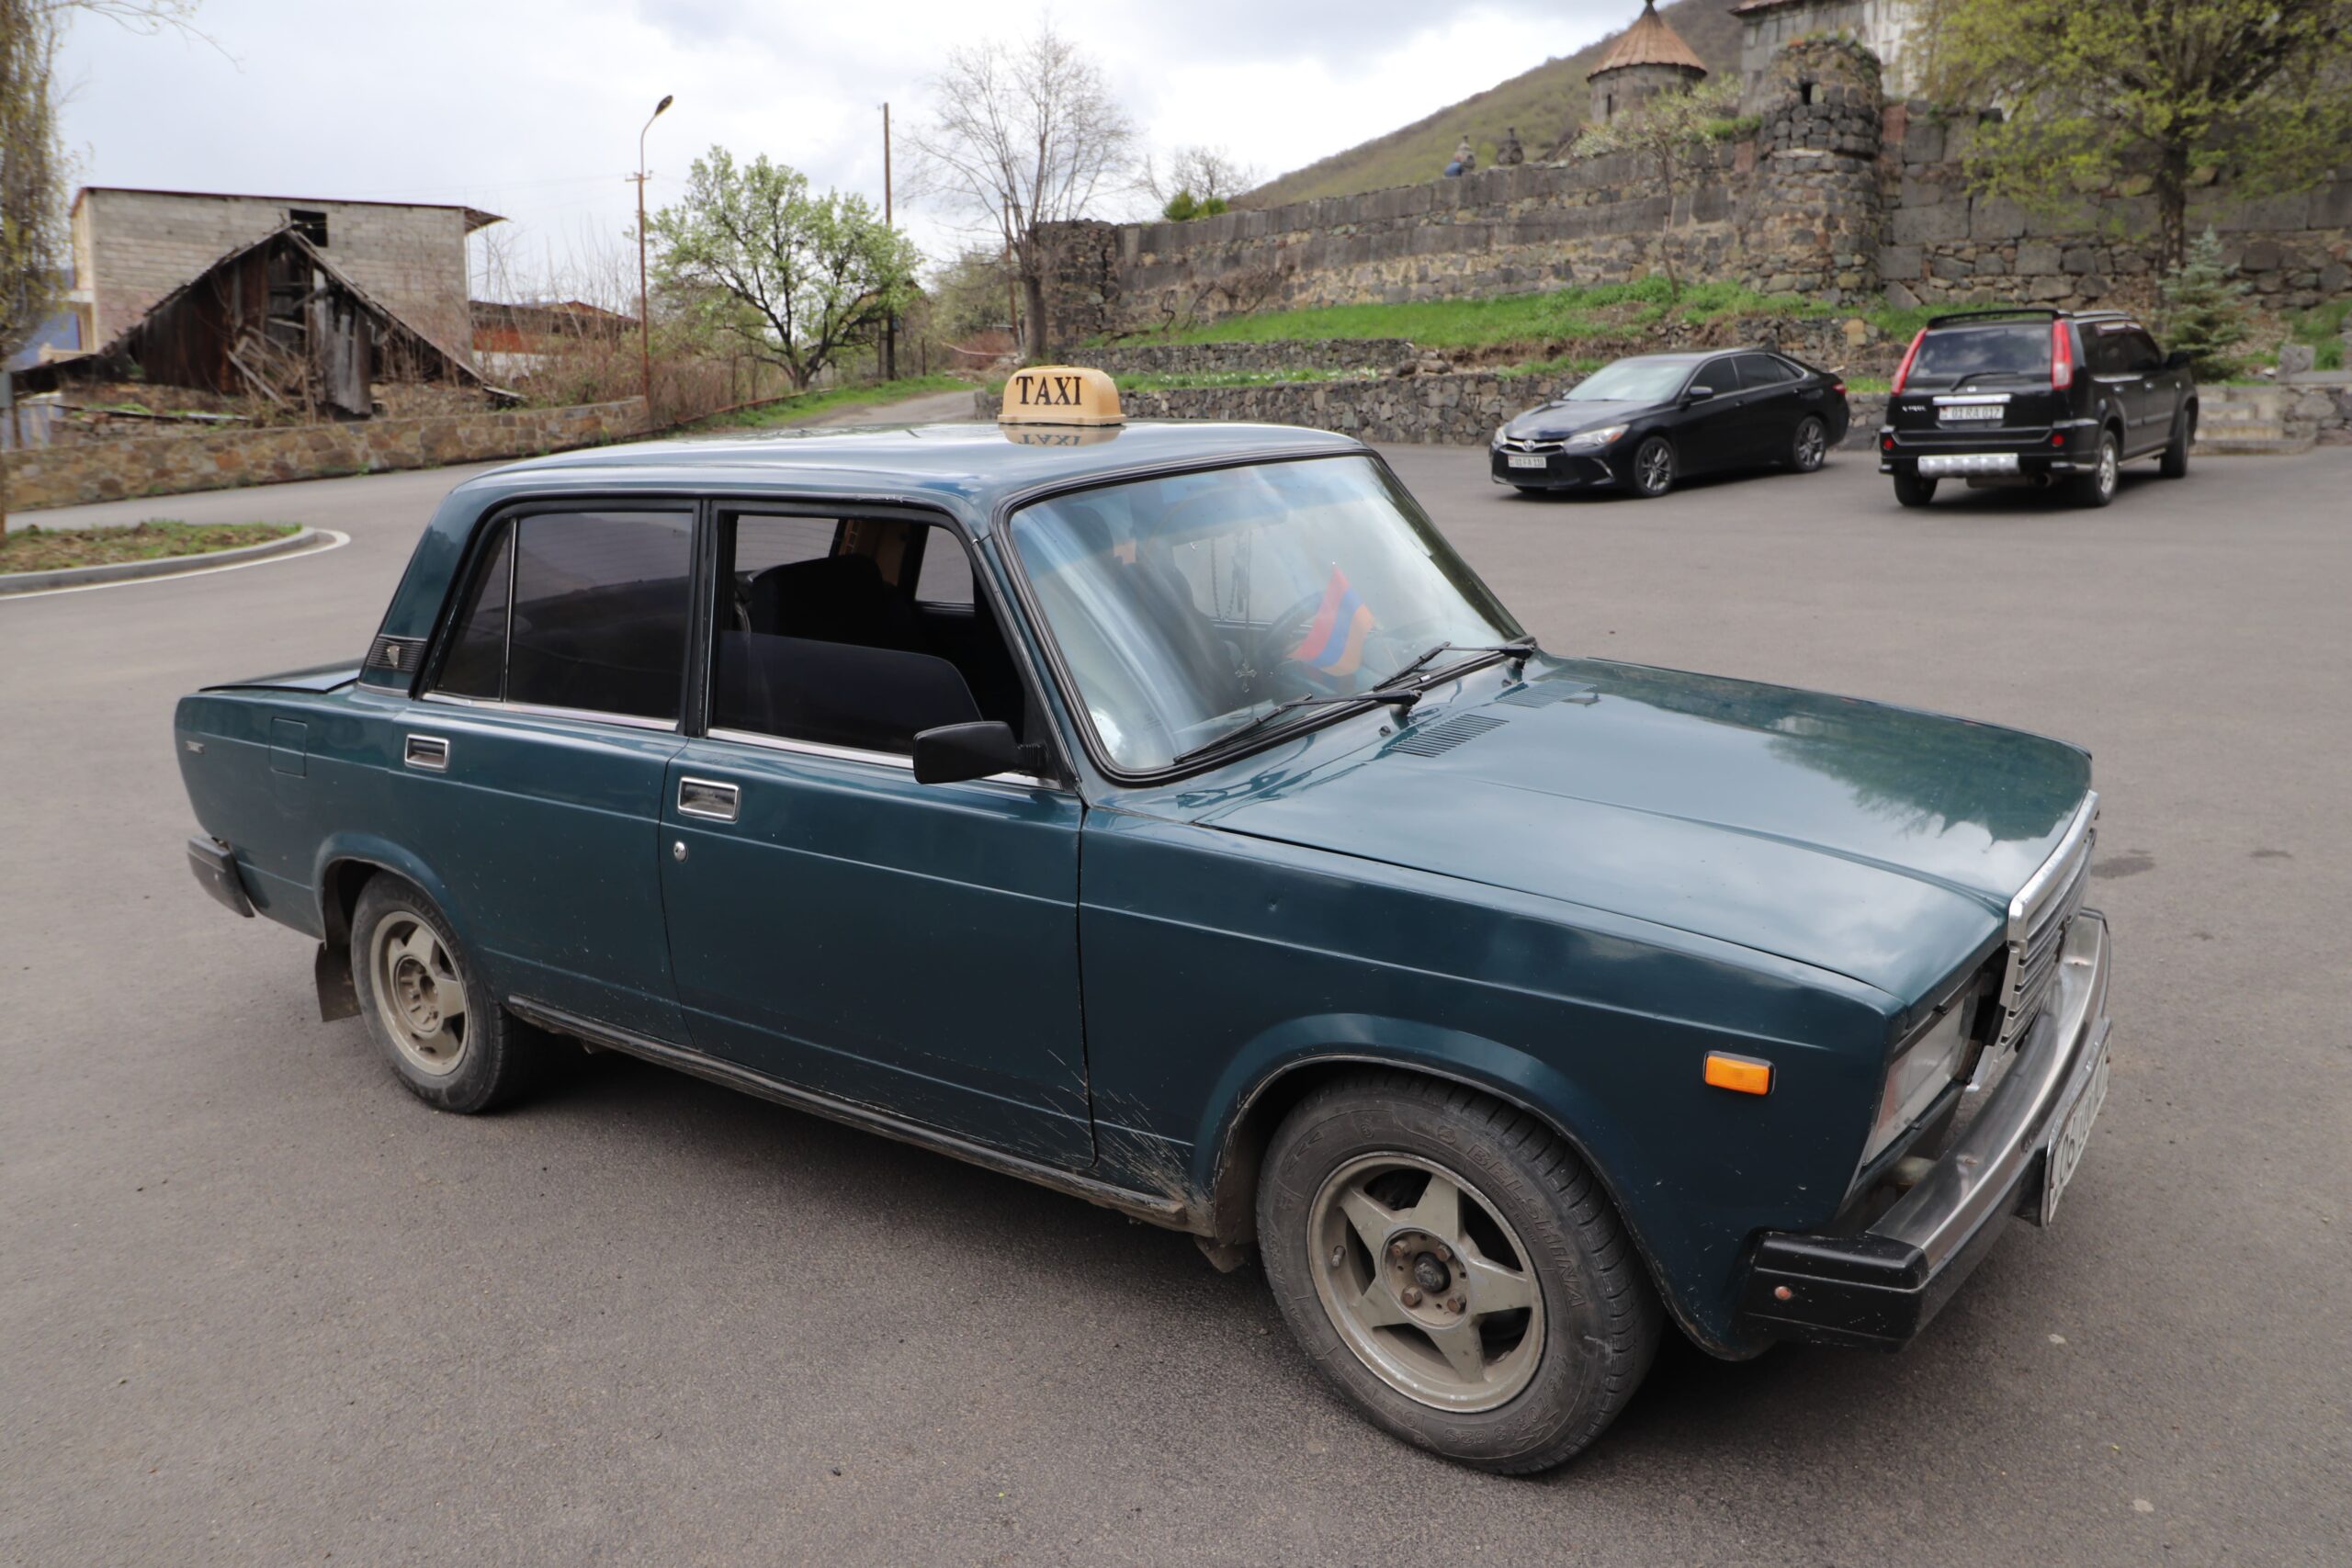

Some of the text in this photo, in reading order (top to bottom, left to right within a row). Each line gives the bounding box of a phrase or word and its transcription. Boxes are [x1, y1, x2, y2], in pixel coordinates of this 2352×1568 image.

[1015, 376, 1082, 405] TAXI
[1466, 1144, 1587, 1308] BELSHINA
[1442, 1427, 1487, 1445] 82S
